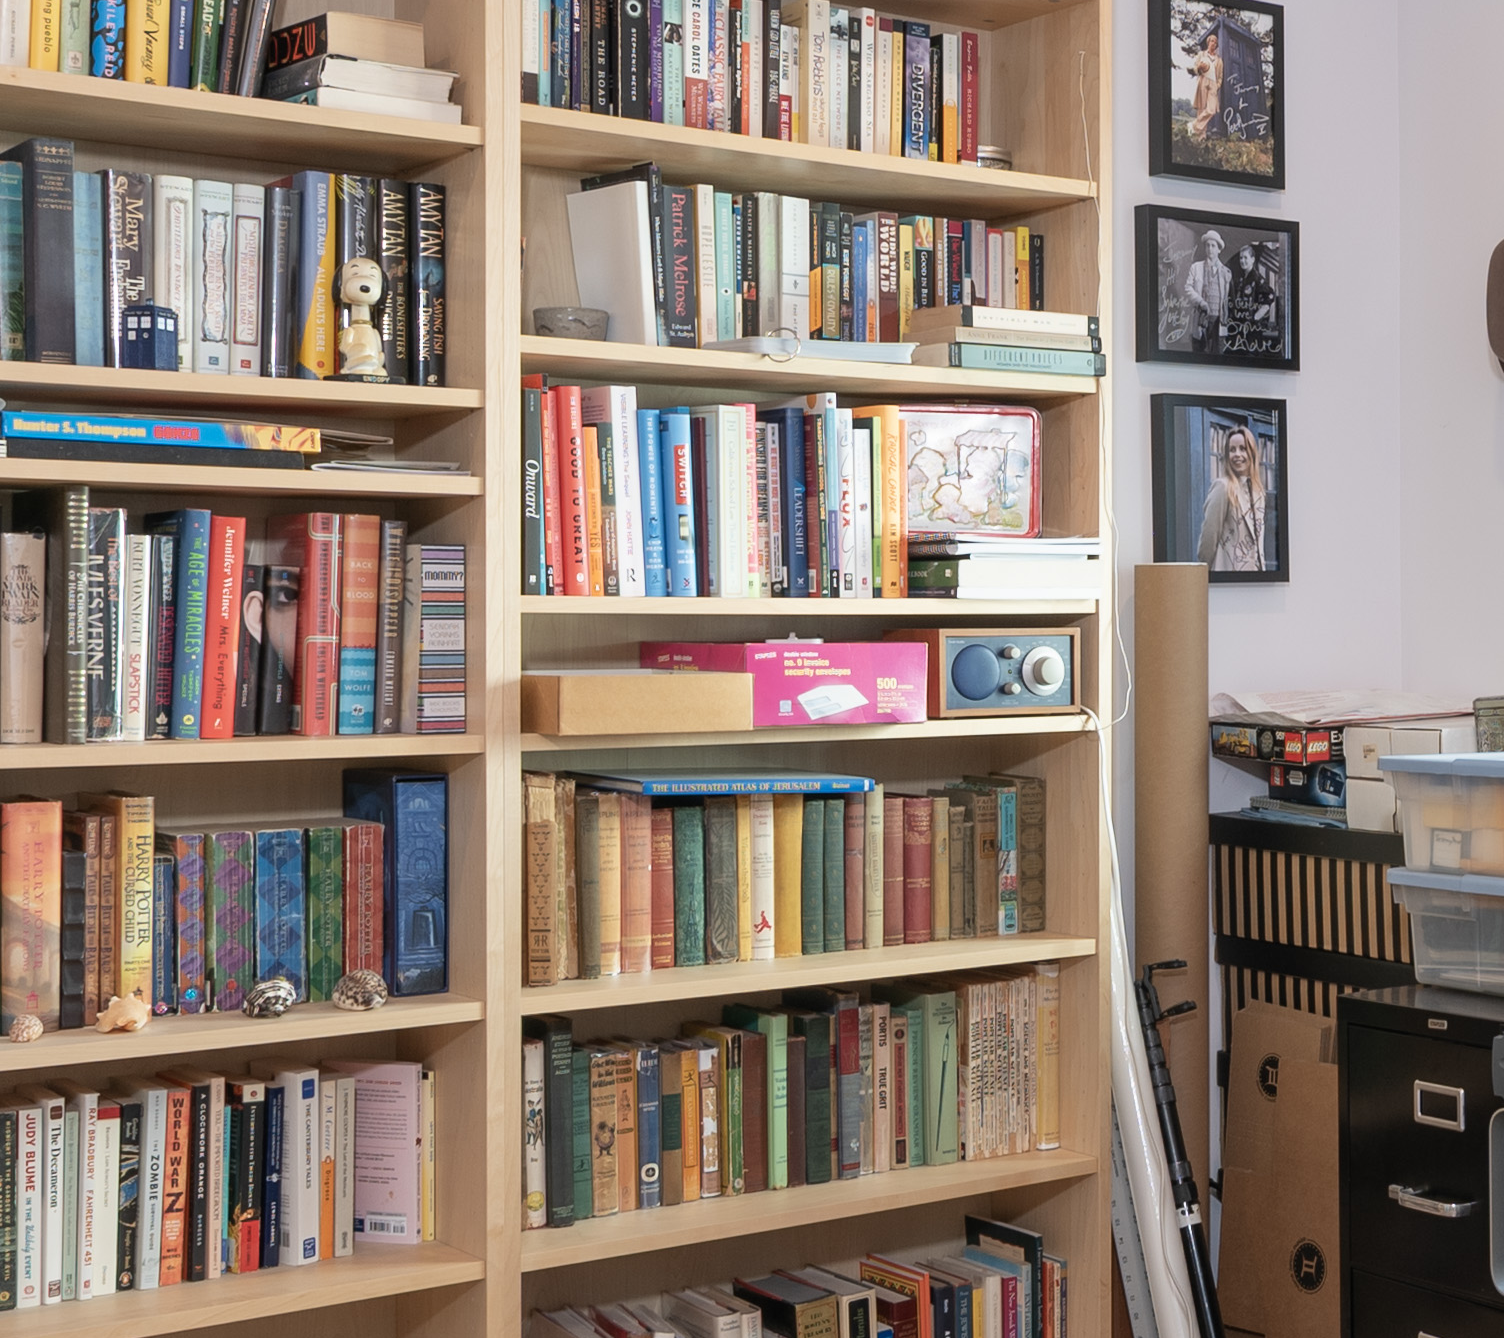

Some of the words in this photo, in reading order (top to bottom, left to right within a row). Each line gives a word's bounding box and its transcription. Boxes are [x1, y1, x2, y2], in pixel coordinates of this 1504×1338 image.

[44, 22, 53, 53] pueblo
[691, 14, 701, 44] CAROL
[691, 46, 701, 75] OATES
[911, 64, 924, 153] DIVERGENT
[382, 189, 405, 221] AMY
[671, 192, 689, 250] Patrick
[382, 223, 406, 257] TAN
[672, 256, 688, 317] Melrose
[525, 459, 540, 519] Onward
[676, 447, 689, 502] SWITCH
[424, 569, 464, 582] MOMMY?
[129, 654, 140, 715] SLAPSTICK
[344, 684, 371, 692] WOLFE
[350, 670, 368, 678] TOM
[1308, 742, 1329, 752] LEGO
[652, 782, 668, 792] THE
[671, 782, 724, 793] ILLUSTRATED
[727, 782, 756, 792] ATLAS
[759, 782, 769, 791] OF
[772, 781, 821, 791] JERUSALEM
[136, 835, 150, 887] HARRY
[135, 893, 149, 947] POTTER
[879, 1016, 887, 1048] PORTIS
[879, 1067, 887, 1089] TRUE
[879, 1091, 887, 1110] GRIT
[171, 1098, 184, 1153] WORLD
[169, 1156, 181, 1189] WAR
[165, 1192, 184, 1214] Z
